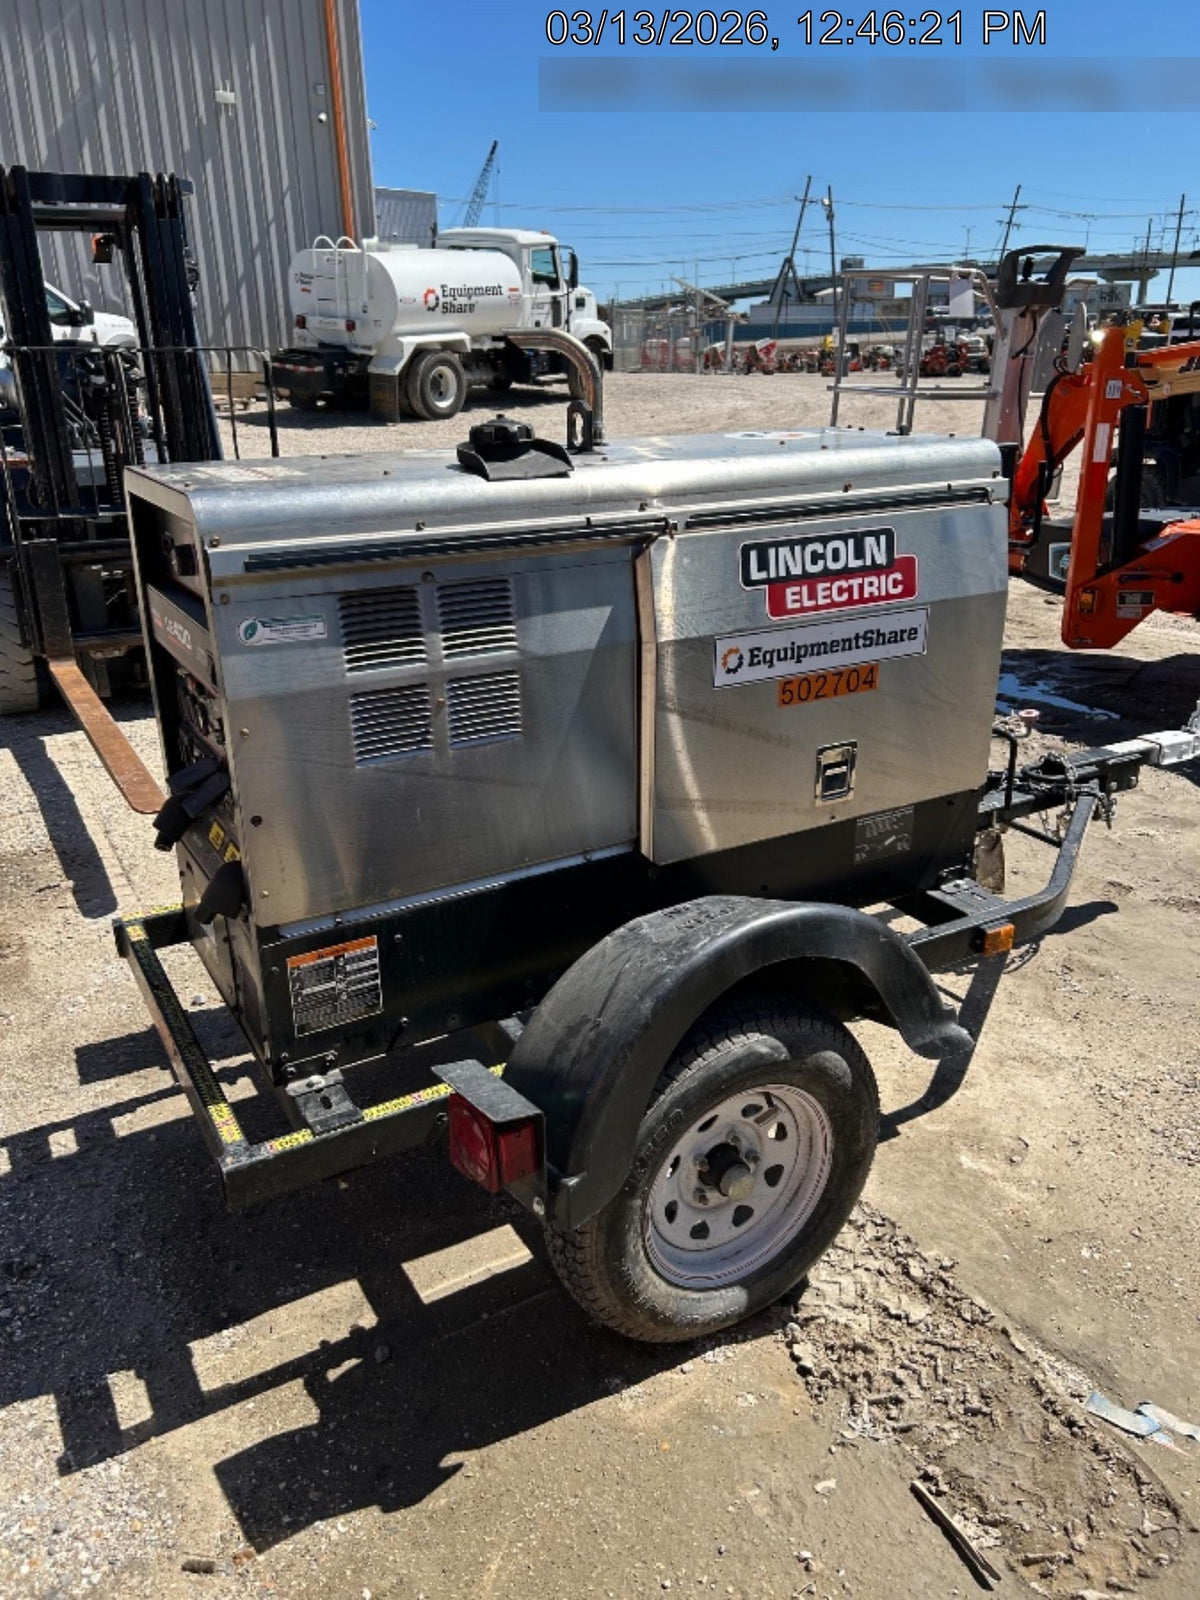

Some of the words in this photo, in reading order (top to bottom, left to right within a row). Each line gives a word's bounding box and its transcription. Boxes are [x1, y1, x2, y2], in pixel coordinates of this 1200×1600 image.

[440, 283, 504, 300] Equipment
[441, 301, 477, 314] Share
[749, 534, 888, 581] LINCOLN
[785, 571, 904, 610] ELECTRIC
[747, 626, 920, 669] EquipmentShare
[780, 663, 878, 706] 502704
